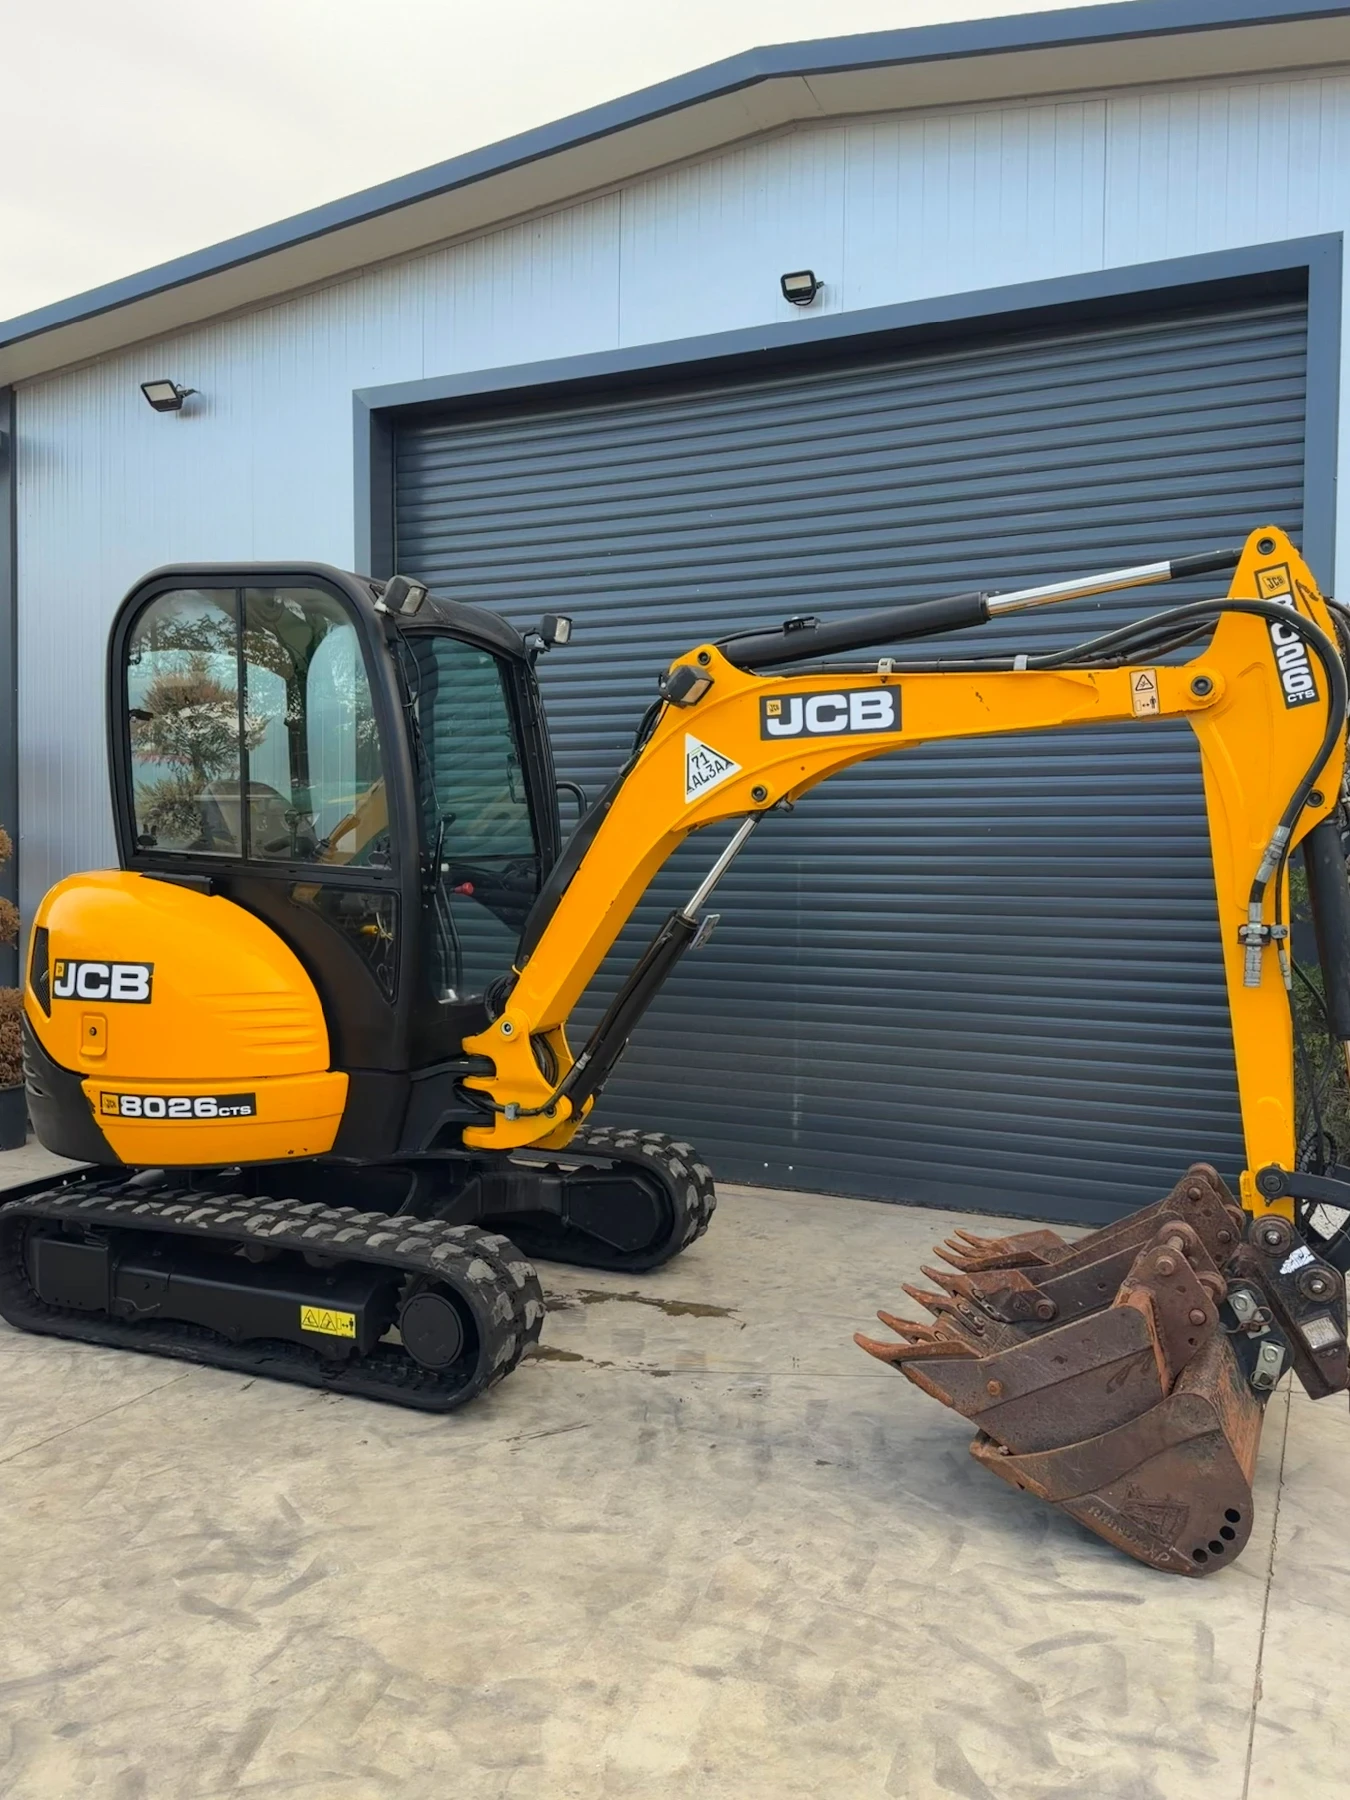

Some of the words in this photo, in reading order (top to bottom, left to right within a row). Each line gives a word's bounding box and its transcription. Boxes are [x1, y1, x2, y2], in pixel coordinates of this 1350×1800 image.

[1287, 689, 1316, 703] CTS
[767, 691, 895, 736] JCB
[691, 752, 710, 769] 71
[54, 963, 150, 1001] JCB
[120, 1096, 218, 1118] 8026
[218, 1105, 252, 1116] CTS
